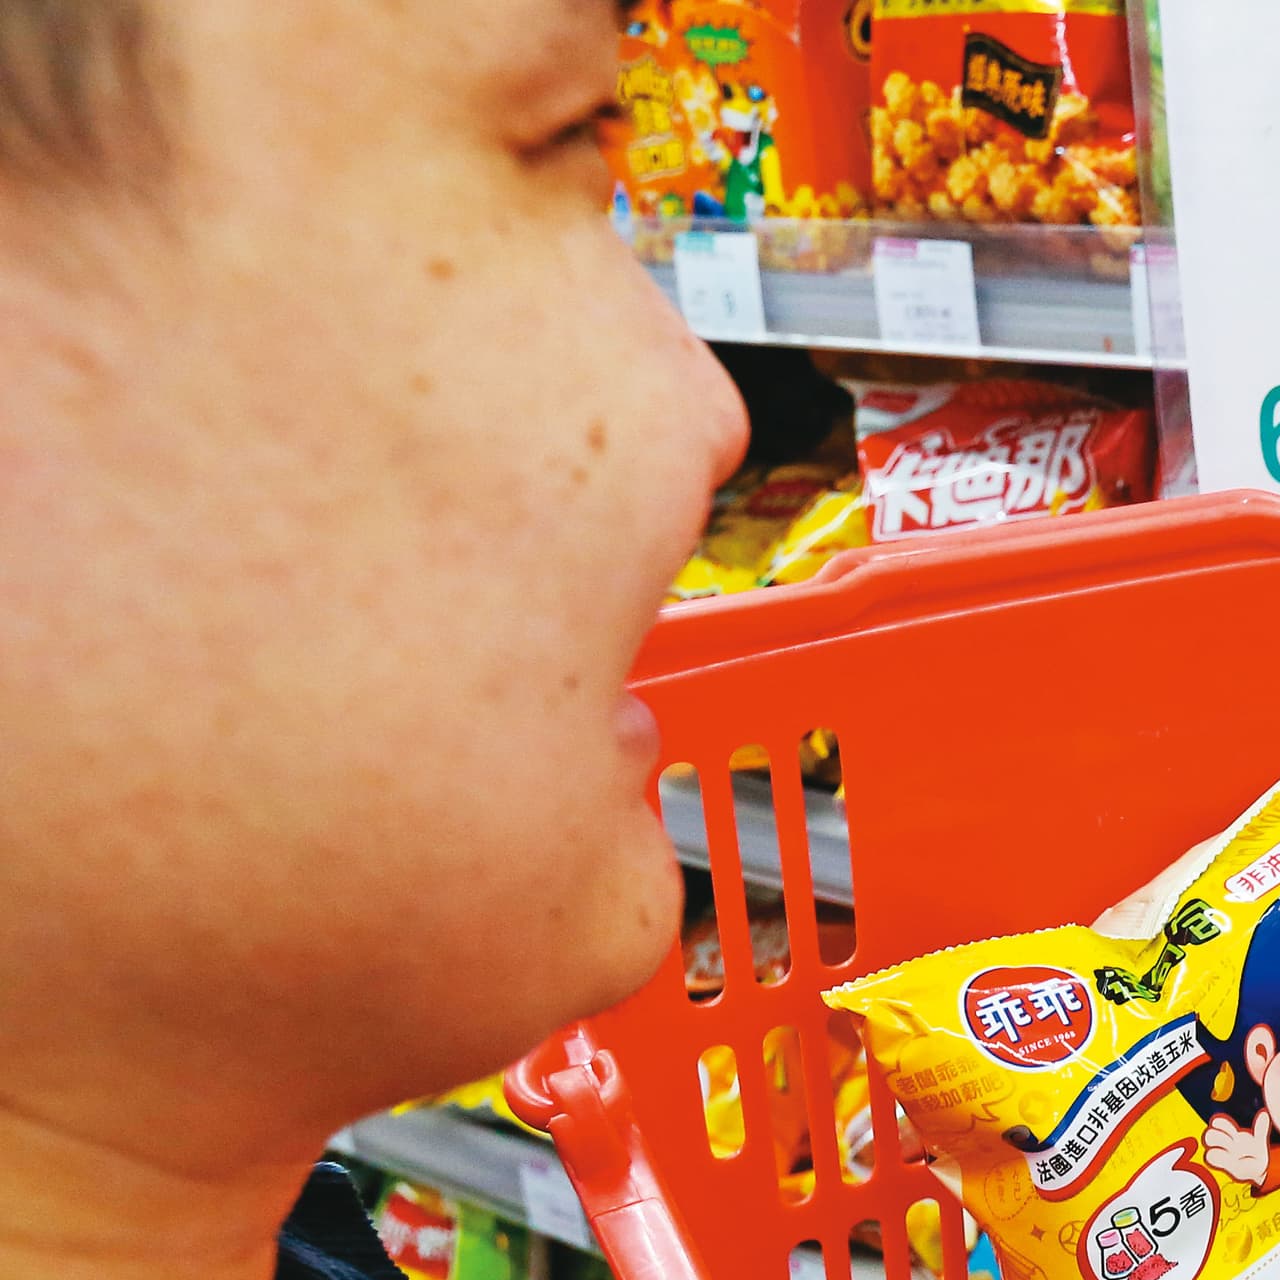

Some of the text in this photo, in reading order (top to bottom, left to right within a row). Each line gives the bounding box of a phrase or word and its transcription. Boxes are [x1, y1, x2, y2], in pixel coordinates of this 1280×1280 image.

[976, 977, 1084, 1044] 乖乖
[1019, 1029, 1077, 1057] SINCE 1968
[1036, 1031, 1195, 1185] 法國進口非基因改造玉米
[1149, 1184, 1207, 1238] 5香
